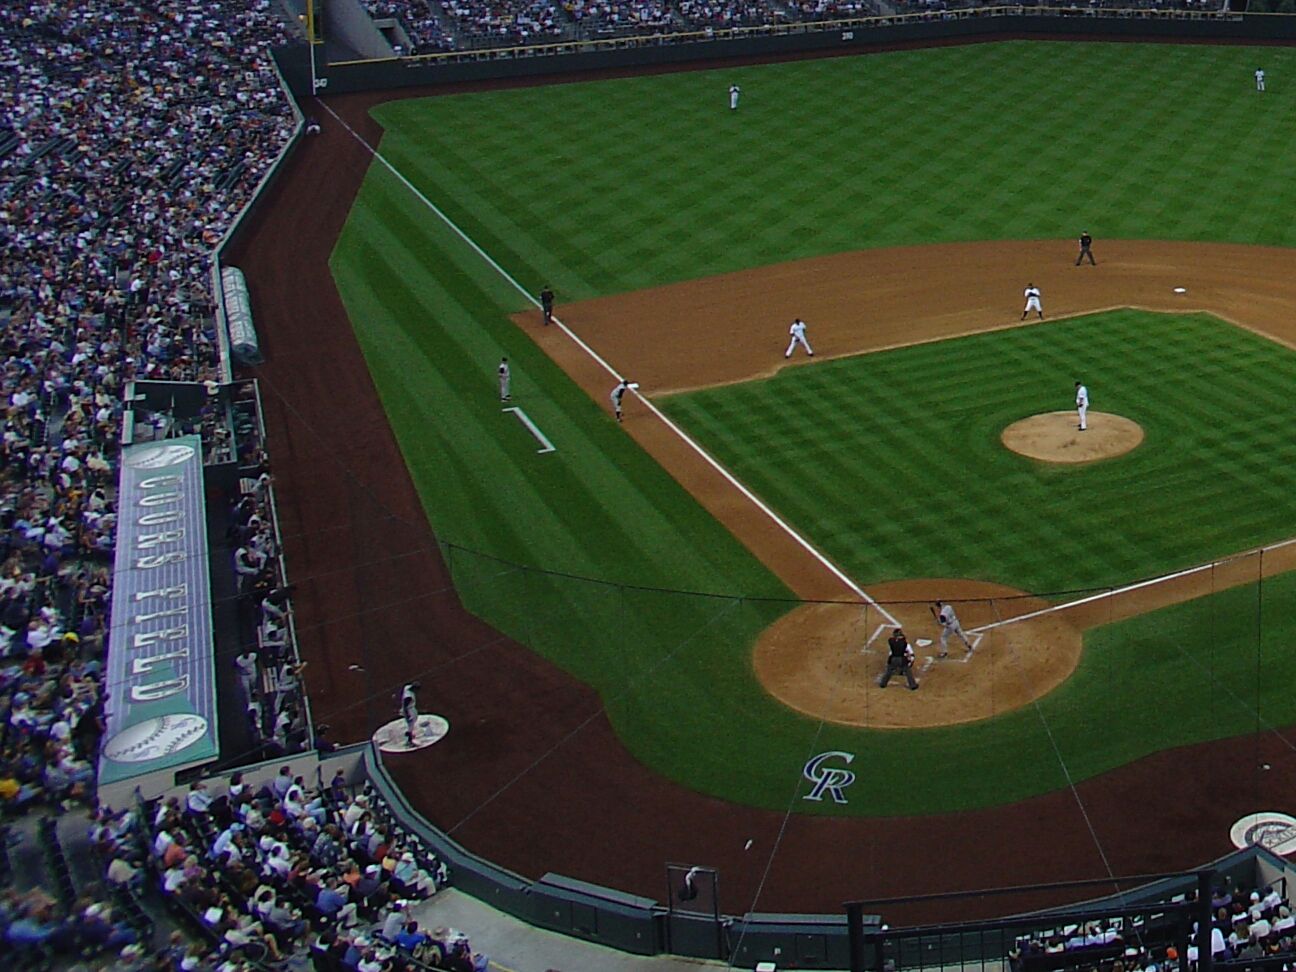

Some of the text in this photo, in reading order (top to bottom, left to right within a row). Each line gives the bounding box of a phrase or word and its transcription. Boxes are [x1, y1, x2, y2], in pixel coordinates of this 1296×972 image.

[131, 474, 189, 702] COORS FIELD
[802, 750, 856, 804] CR
